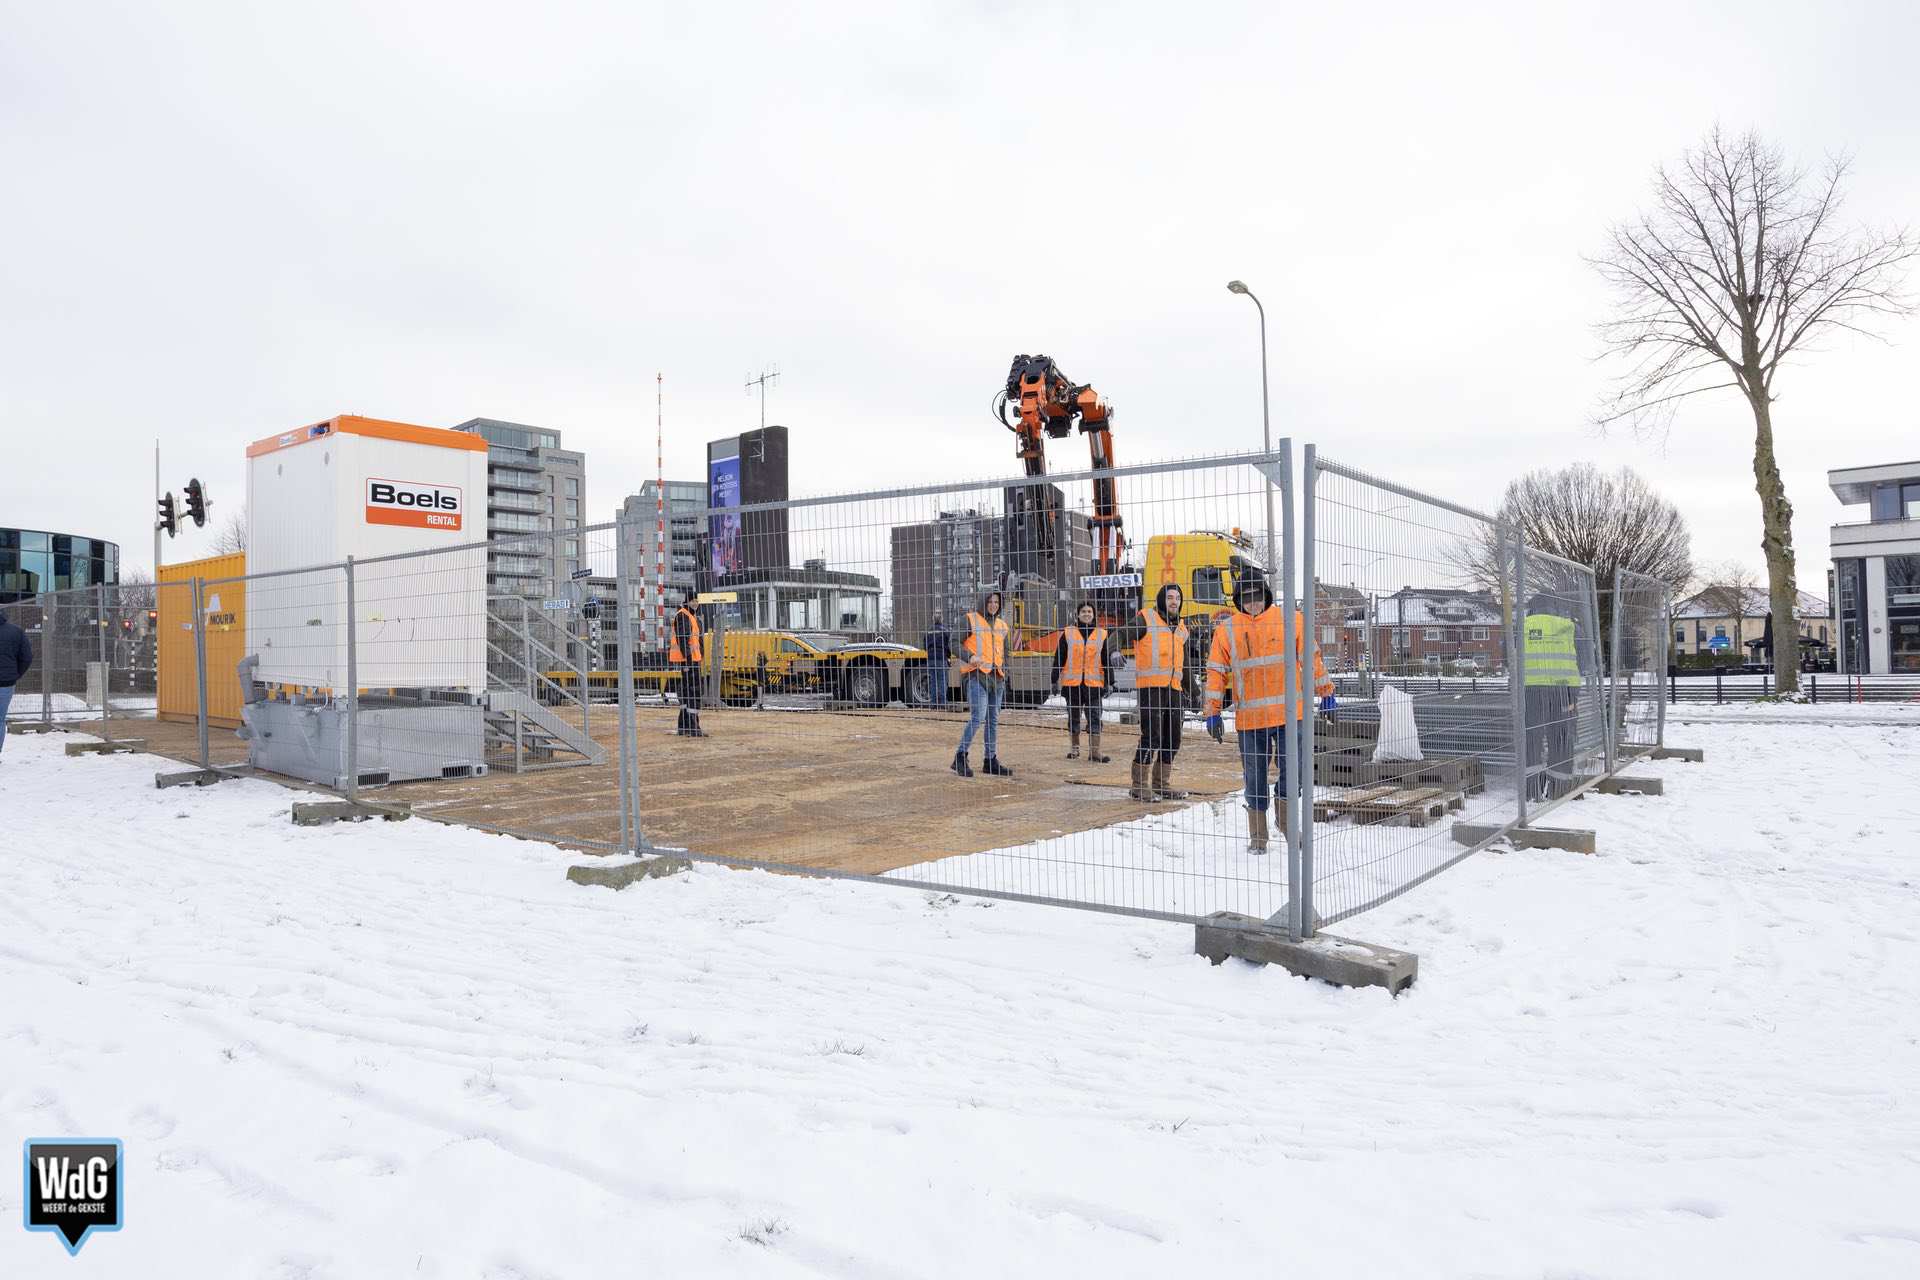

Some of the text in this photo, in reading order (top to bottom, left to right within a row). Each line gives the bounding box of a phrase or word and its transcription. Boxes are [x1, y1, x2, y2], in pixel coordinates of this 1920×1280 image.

[371, 483, 458, 510] Boels
[426, 514, 457, 526] RENTAL
[1082, 575, 1132, 588] HERAS
